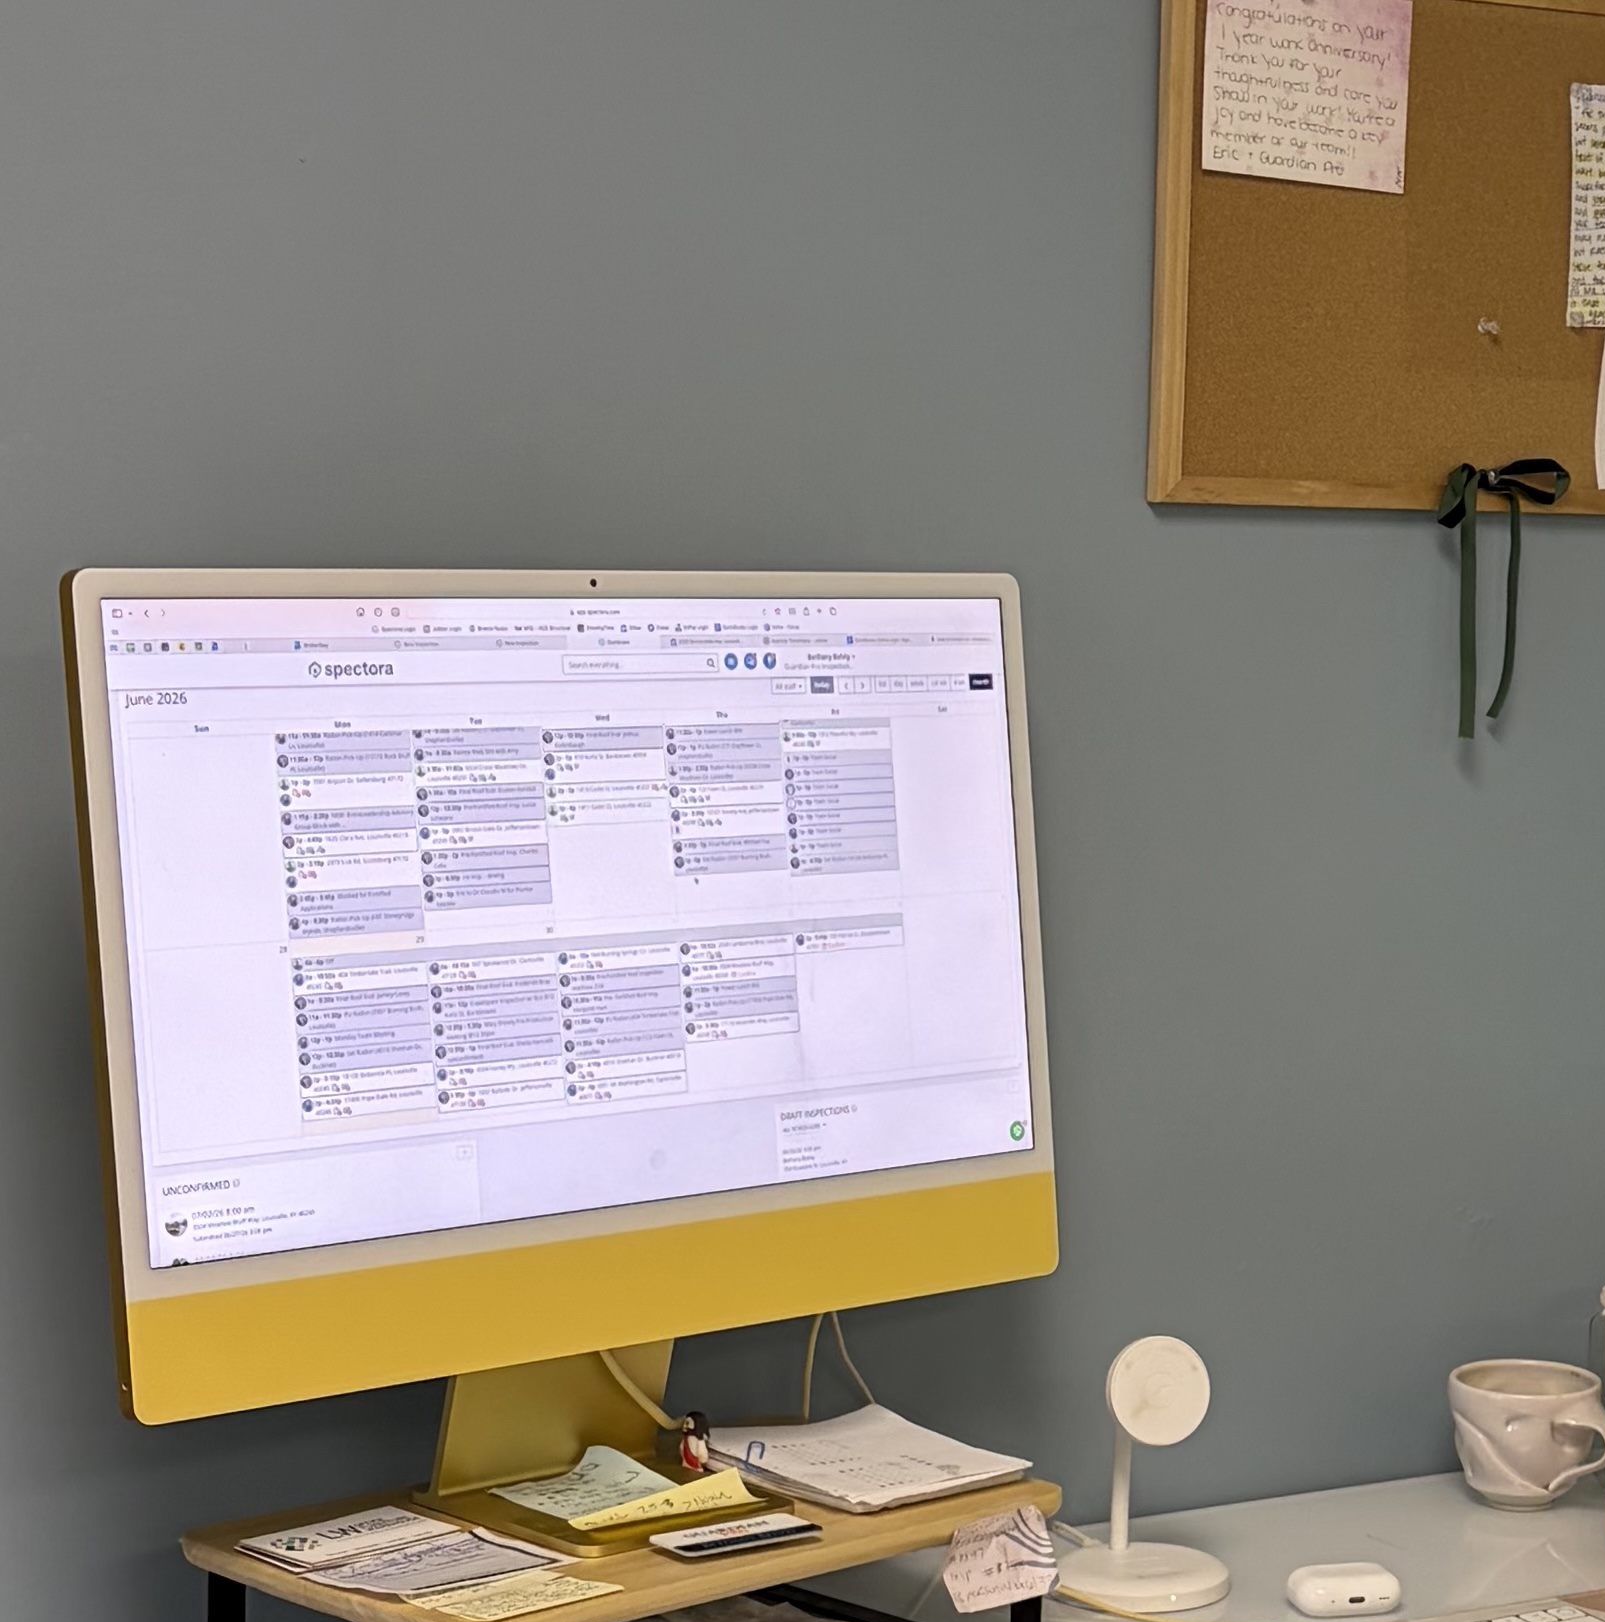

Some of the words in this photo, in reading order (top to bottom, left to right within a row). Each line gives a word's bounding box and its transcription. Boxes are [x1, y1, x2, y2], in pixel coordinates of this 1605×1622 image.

[1216, 2, 1327, 32] Congratulations
[1332, 22, 1350, 33] on
[1357, 25, 1388, 44] your
[1233, 30, 1265, 49] year
[1270, 37, 1303, 50] work
[1216, 45, 1257, 64] Thank
[1261, 54, 1284, 69] you
[1289, 58, 1309, 71] for
[1313, 63, 1342, 82] your
[1214, 69, 1309, 93] thoughtfulness
[1315, 83, 1338, 97] and
[1344, 88, 1371, 103] care
[1376, 96, 1397, 110] you
[1253, 94, 1267, 104] in
[1272, 97, 1298, 114] your
[1213, 106, 1234, 125] joy
[1239, 110, 1261, 123] and
[1268, 113, 1296, 129] have
[1300, 122, 1344, 138] become
[1361, 132, 1384, 146] key
[1210, 129, 1266, 143] member
[1271, 136, 1285, 147] of
[1290, 137, 1308, 149] our
[1213, 145, 1239, 160] Eric
[1259, 151, 1317, 171] Guardian
[324, 662, 394, 680] spectora
[124, 693, 153, 709] June
[157, 692, 188, 705] 2026
[416, 935, 425, 943] 29
[162, 1180, 231, 1196] UNCONFIRMED
